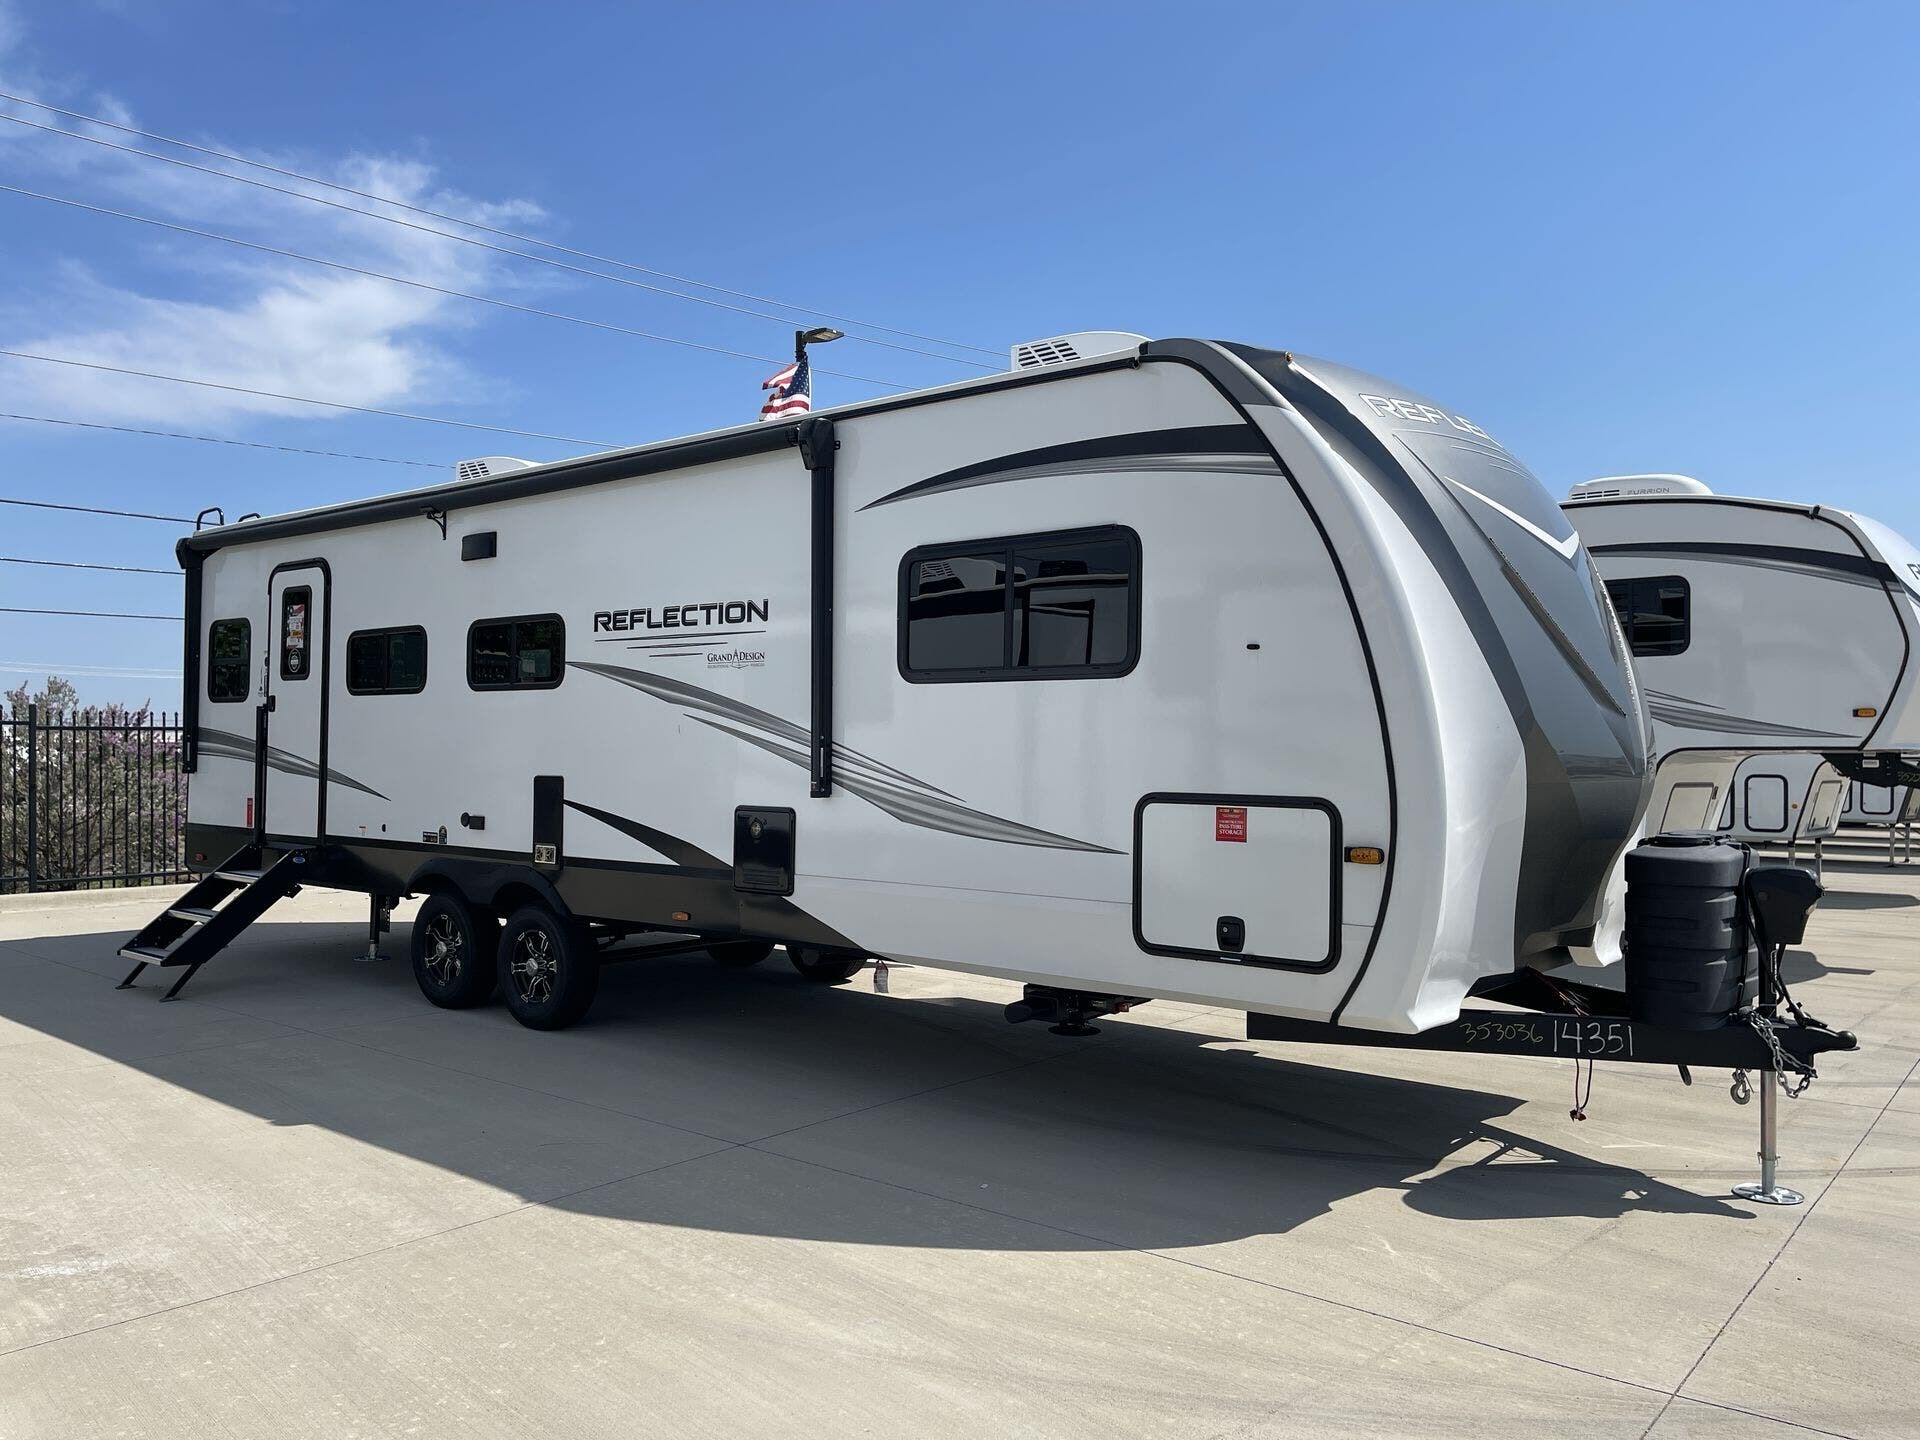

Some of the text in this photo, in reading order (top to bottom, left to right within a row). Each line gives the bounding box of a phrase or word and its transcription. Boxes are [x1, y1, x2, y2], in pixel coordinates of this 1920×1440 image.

[1627, 487, 1670, 496] FURRION
[593, 598, 769, 632] REFLECTION
[1460, 1019, 1634, 1056] 353036 14351
